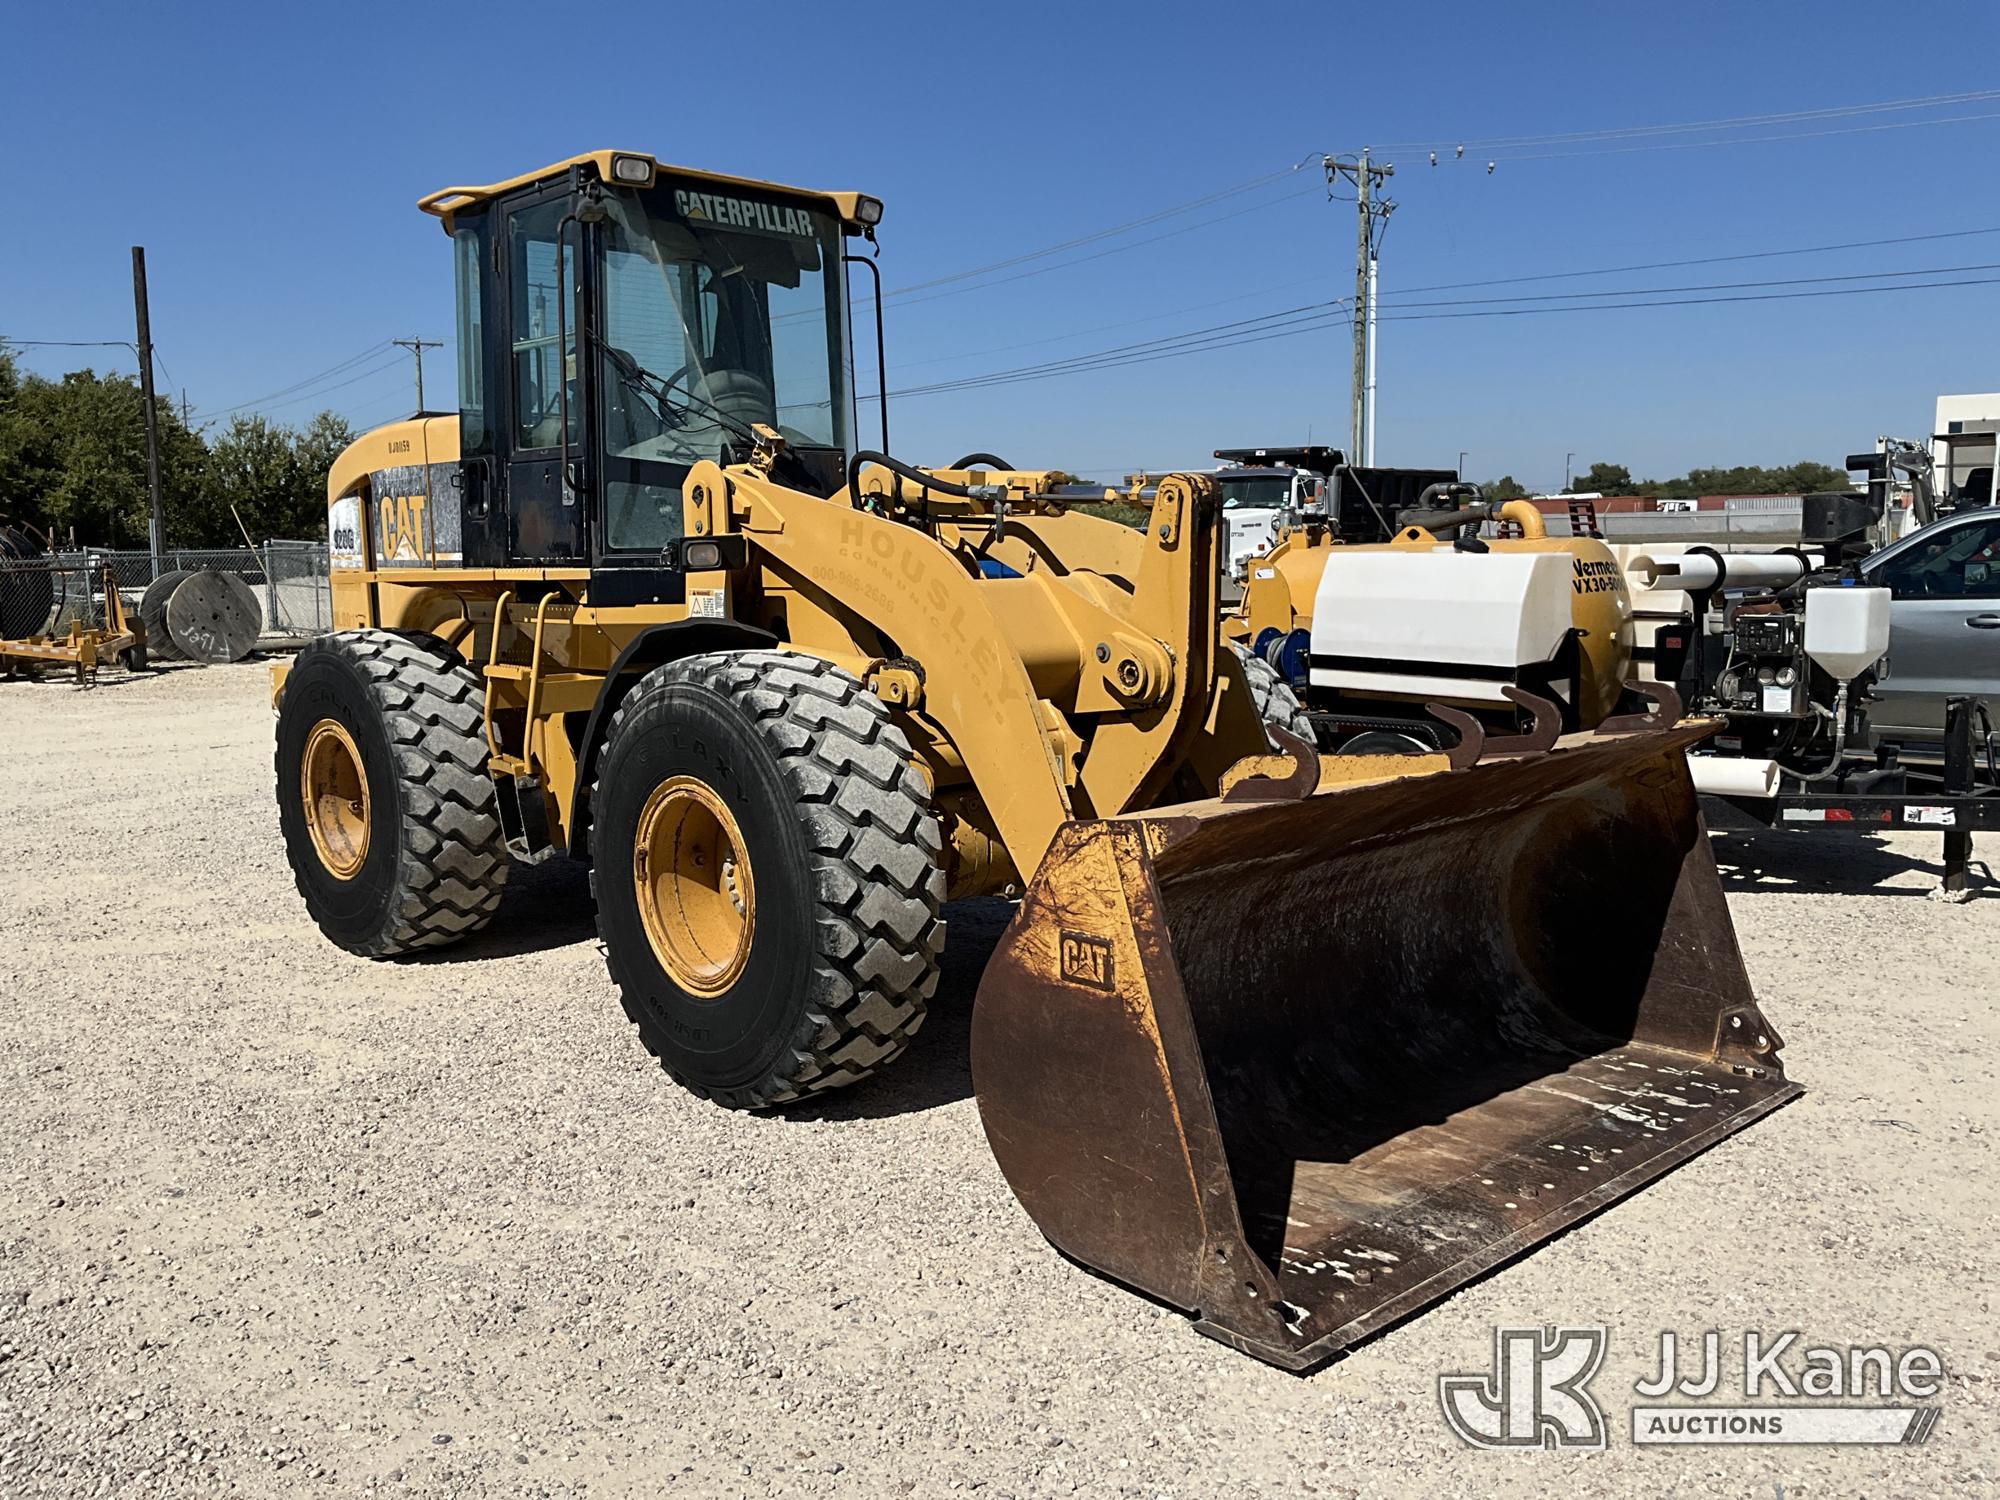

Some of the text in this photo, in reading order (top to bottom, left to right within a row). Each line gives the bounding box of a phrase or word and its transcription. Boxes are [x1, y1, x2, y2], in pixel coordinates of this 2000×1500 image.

[674, 189, 815, 237] CATERPILLAR
[380, 495, 427, 561] CAT
[1061, 938, 1107, 984] CAT
